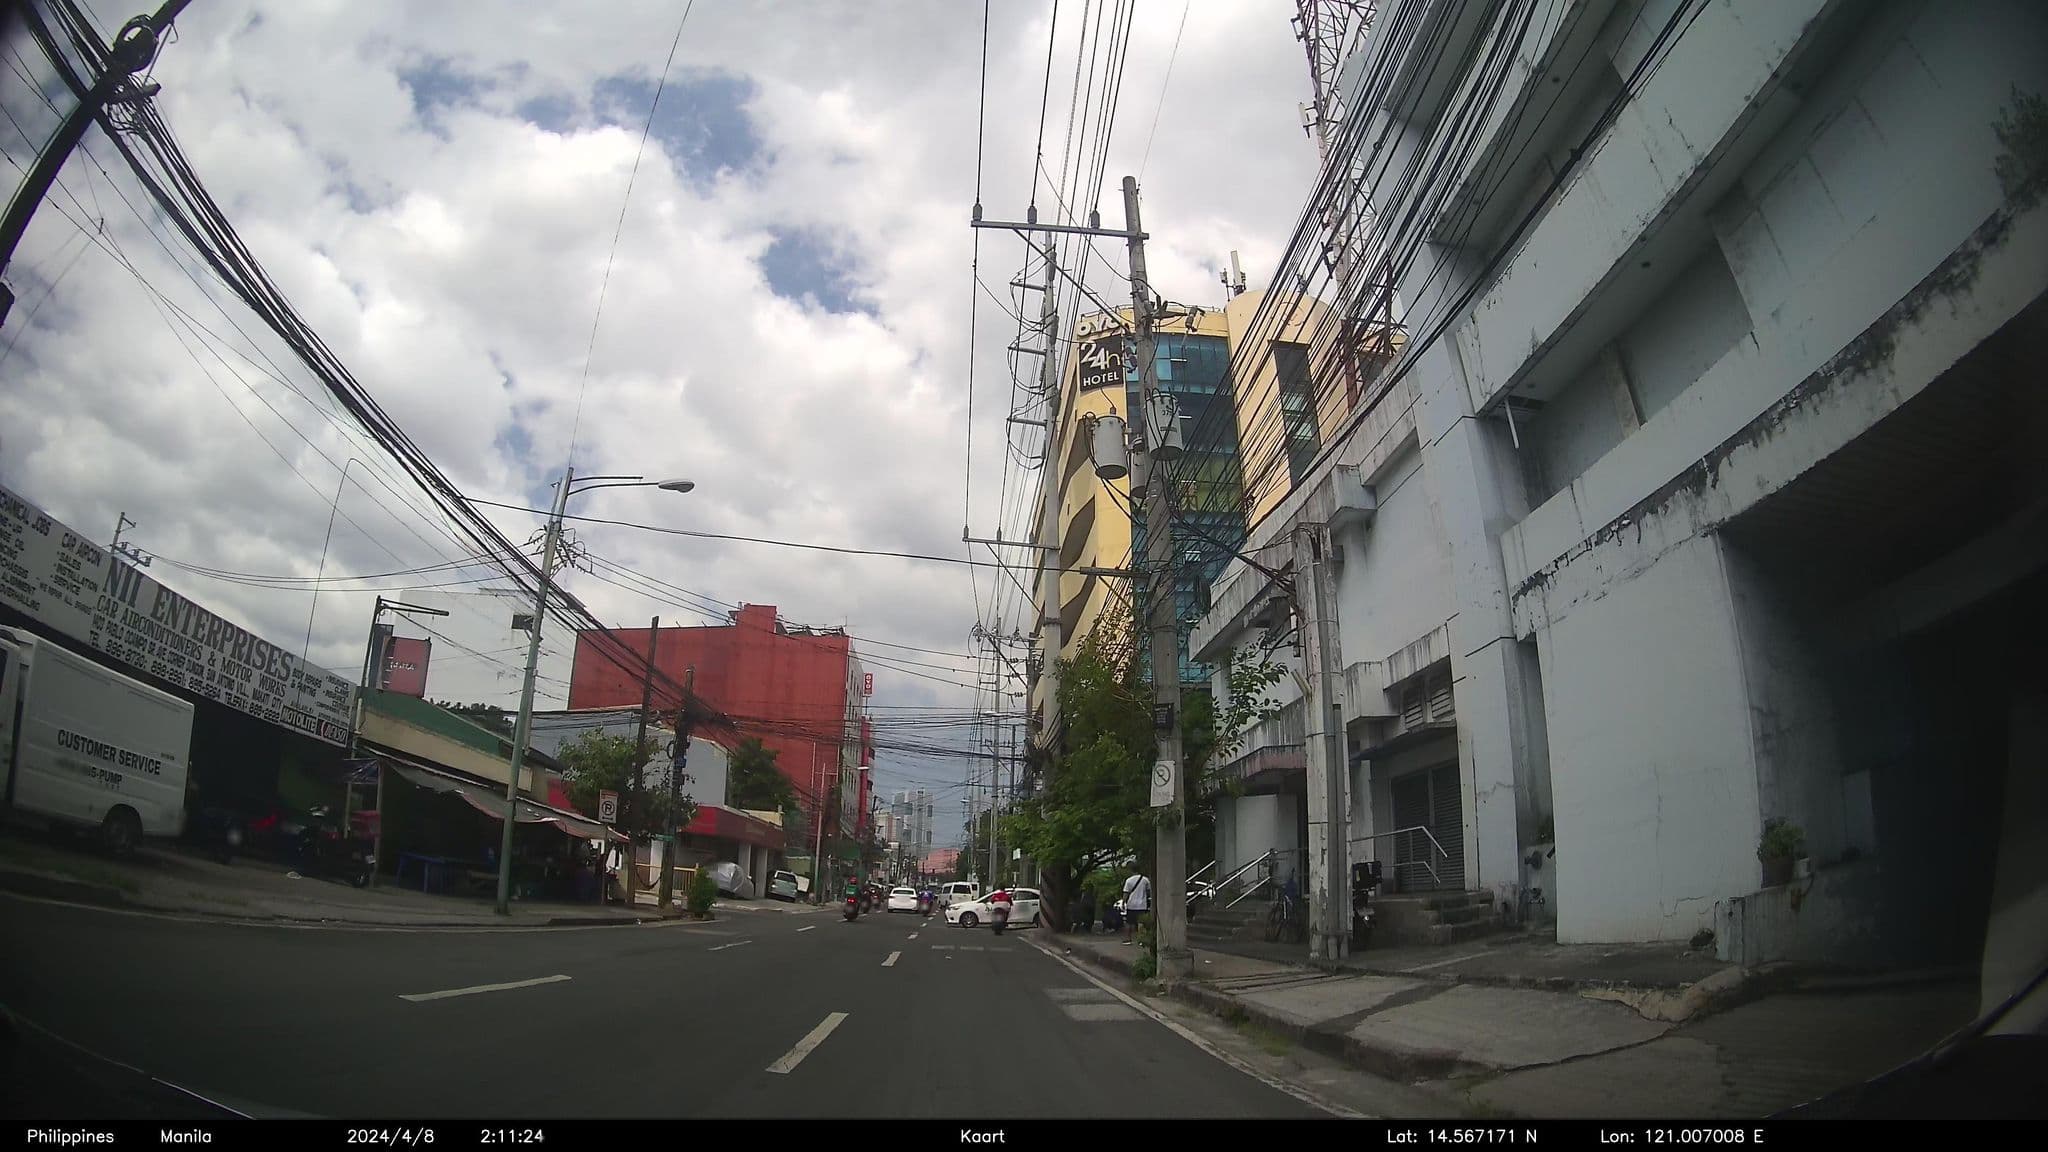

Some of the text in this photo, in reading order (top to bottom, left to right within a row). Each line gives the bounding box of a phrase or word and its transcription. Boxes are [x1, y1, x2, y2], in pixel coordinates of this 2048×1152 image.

[1080, 342, 1121, 370] 24h
[1083, 371, 1120, 387] HOTEL
[59, 552, 82, 571] SALES
[62, 532, 102, 568] CAR AIRCON
[54, 574, 81, 596] SERVICE
[56, 563, 99, 593] INSTALLATION
[97, 594, 287, 698] CAR AIRCONDITIONERS & MOTOR WORKS
[150, 583, 295, 682] ENTERPRISES
[281, 707, 318, 733] MOTOLITE
[57, 728, 116, 763] CUSTOMER
[118, 748, 162, 776] SERVICE
